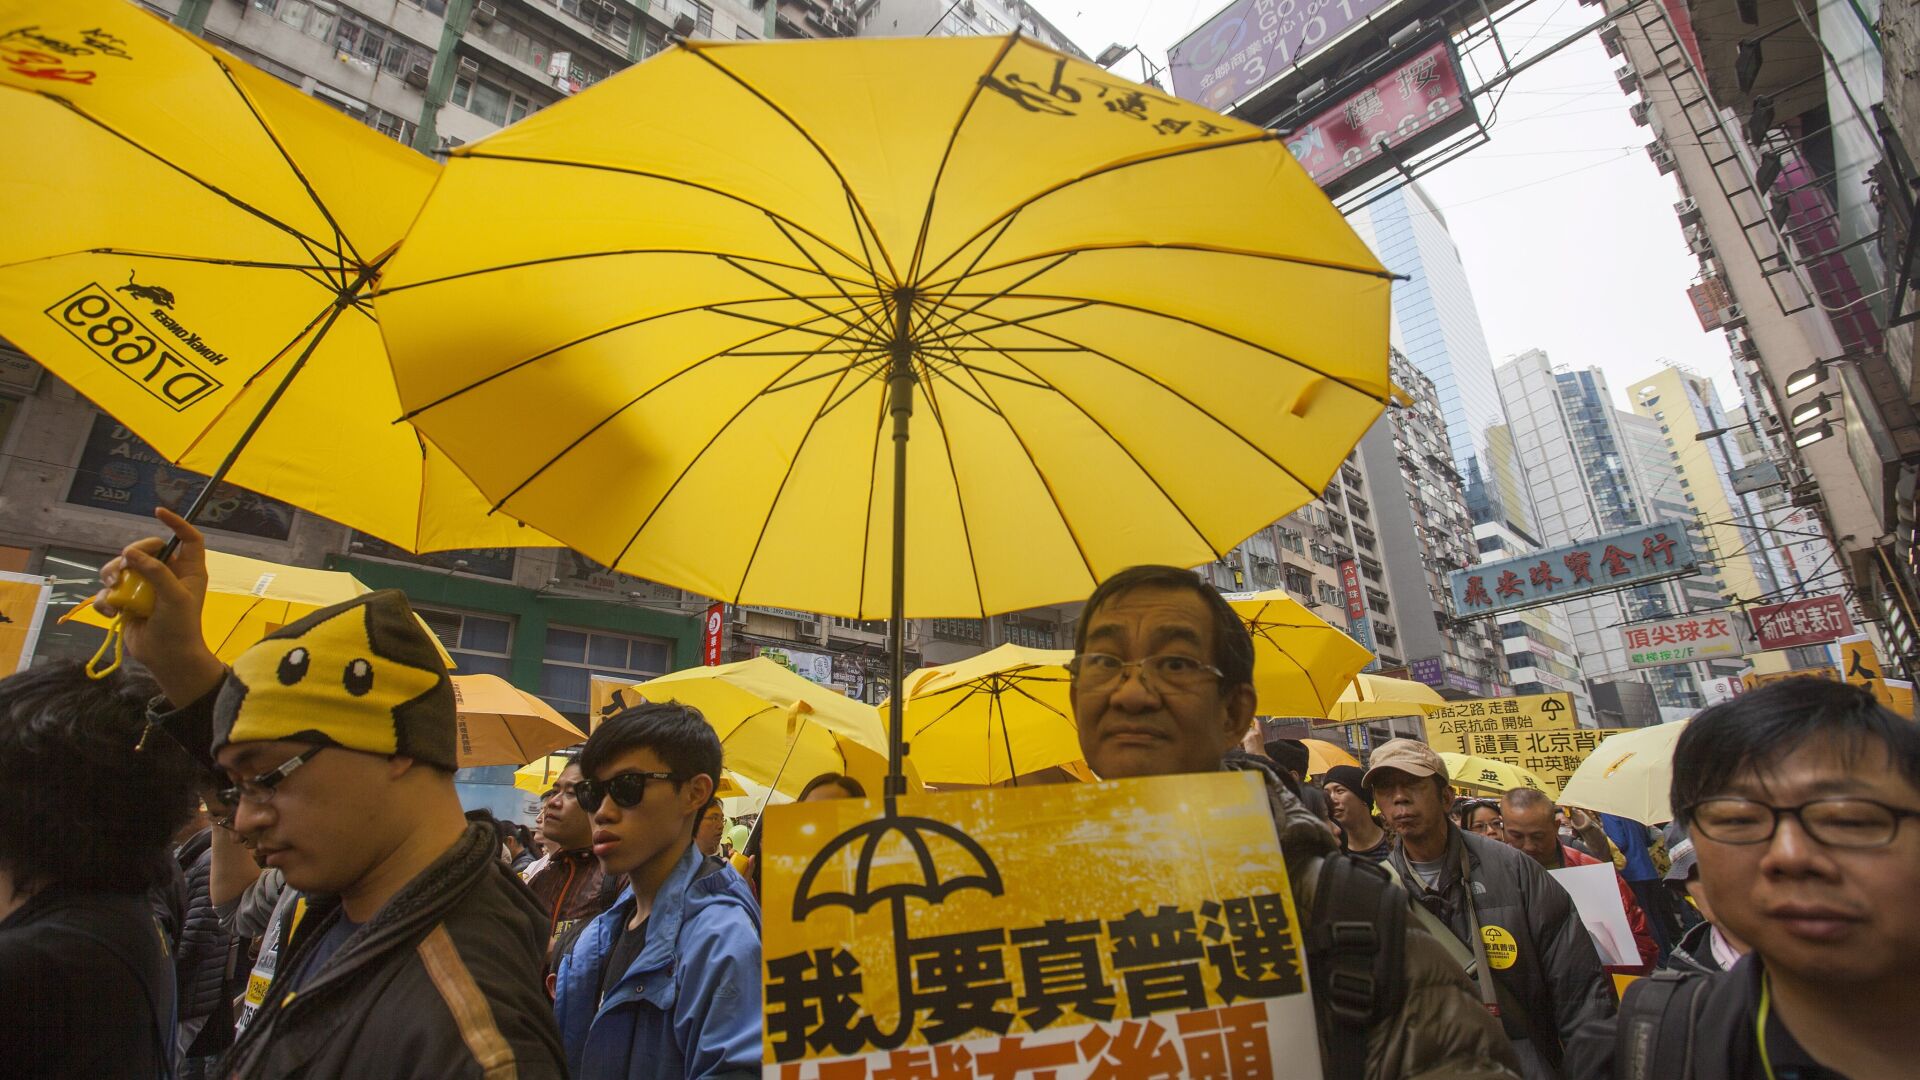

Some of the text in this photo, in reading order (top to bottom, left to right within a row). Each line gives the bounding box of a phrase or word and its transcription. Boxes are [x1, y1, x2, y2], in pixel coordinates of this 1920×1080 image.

[1625, 618, 1730, 650] 頂尖球衣
[1759, 604, 1842, 641] 新世紀表行
[1439, 715, 1533, 734] 公民抗命 開始
[766, 892, 1304, 1063] 我要真普選
